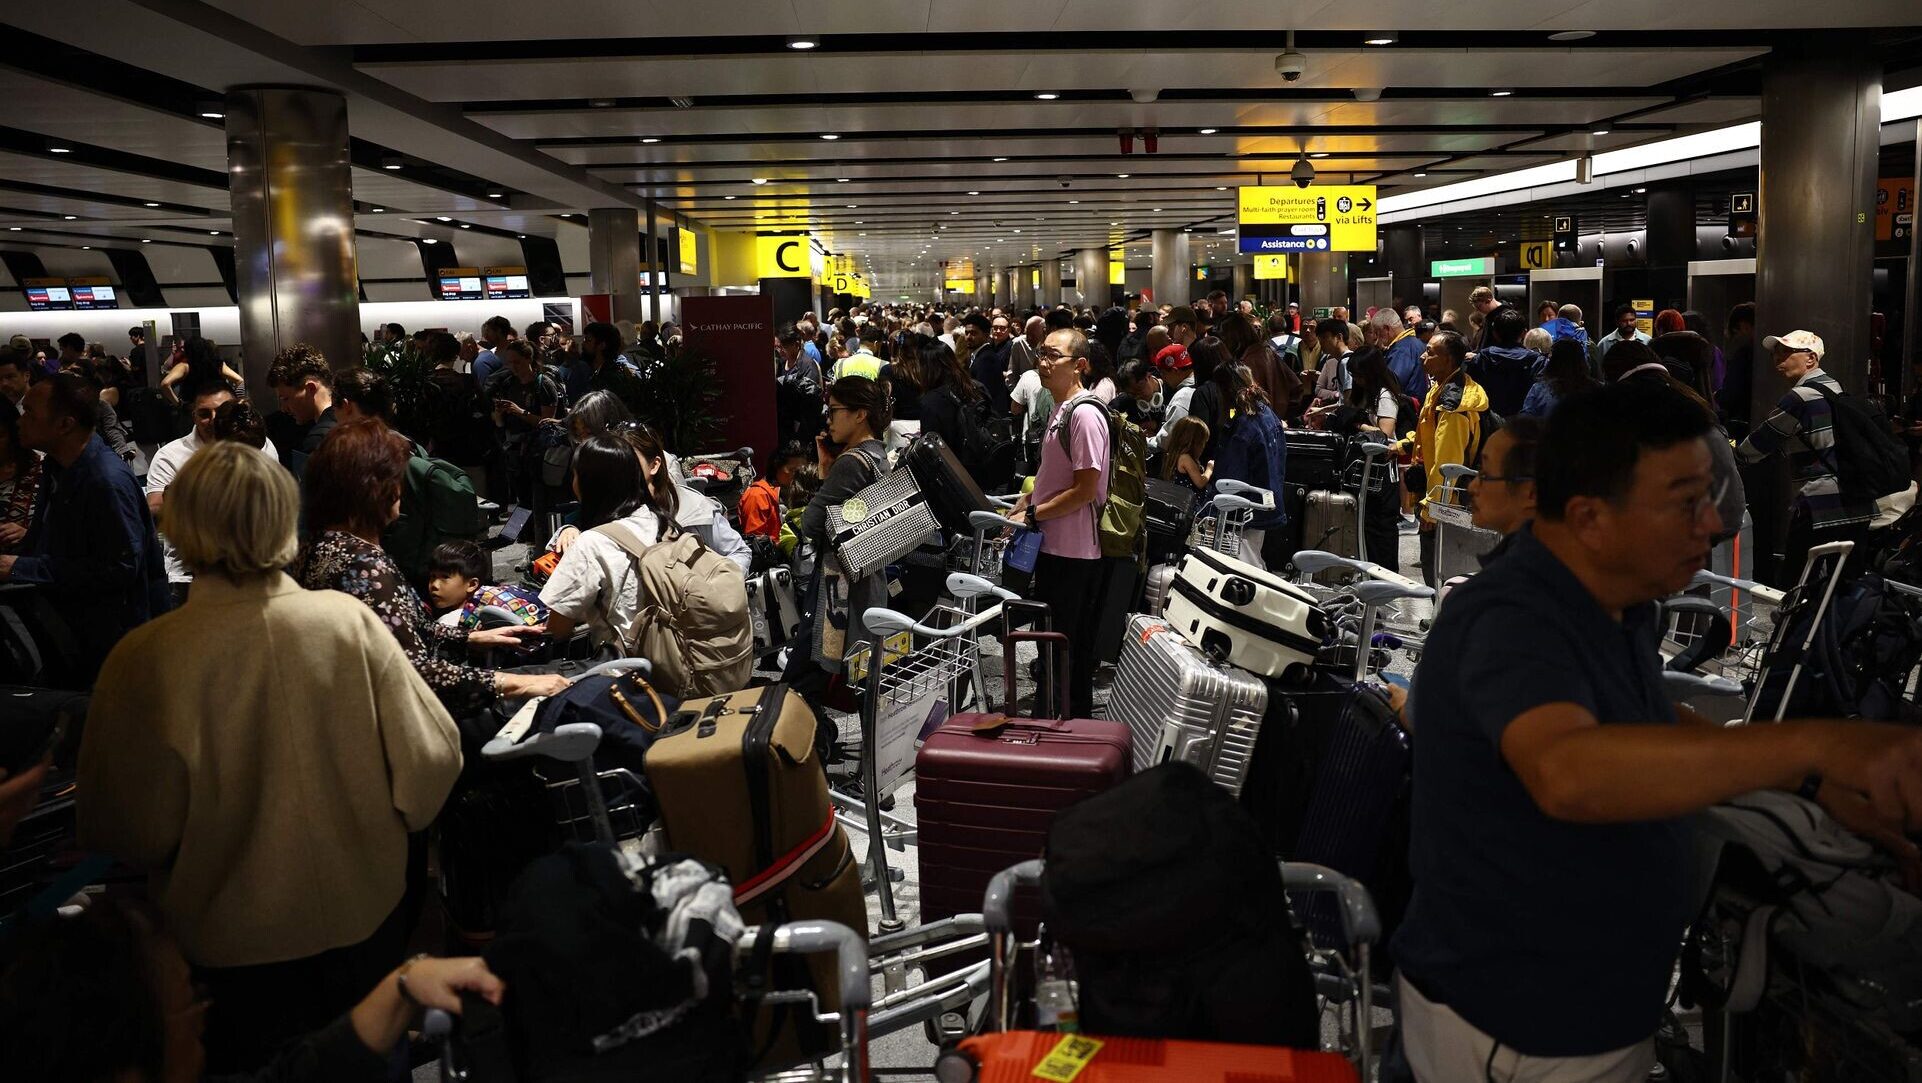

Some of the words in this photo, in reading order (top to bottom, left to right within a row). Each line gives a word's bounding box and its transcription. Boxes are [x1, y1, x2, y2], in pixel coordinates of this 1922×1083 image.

[1269, 198, 1315, 206] Departures
[1335, 216, 1350, 224] via
[1352, 216, 1372, 224] Lifts
[1261, 240, 1305, 248] Assistance
[775, 241, 800, 272] C
[836, 278, 848, 291] D
[700, 323, 732, 331] CATHAY
[733, 322, 763, 330] PACIFIC
[851, 510, 891, 536] CHRISTIAN
[891, 500, 911, 515] DIOR
